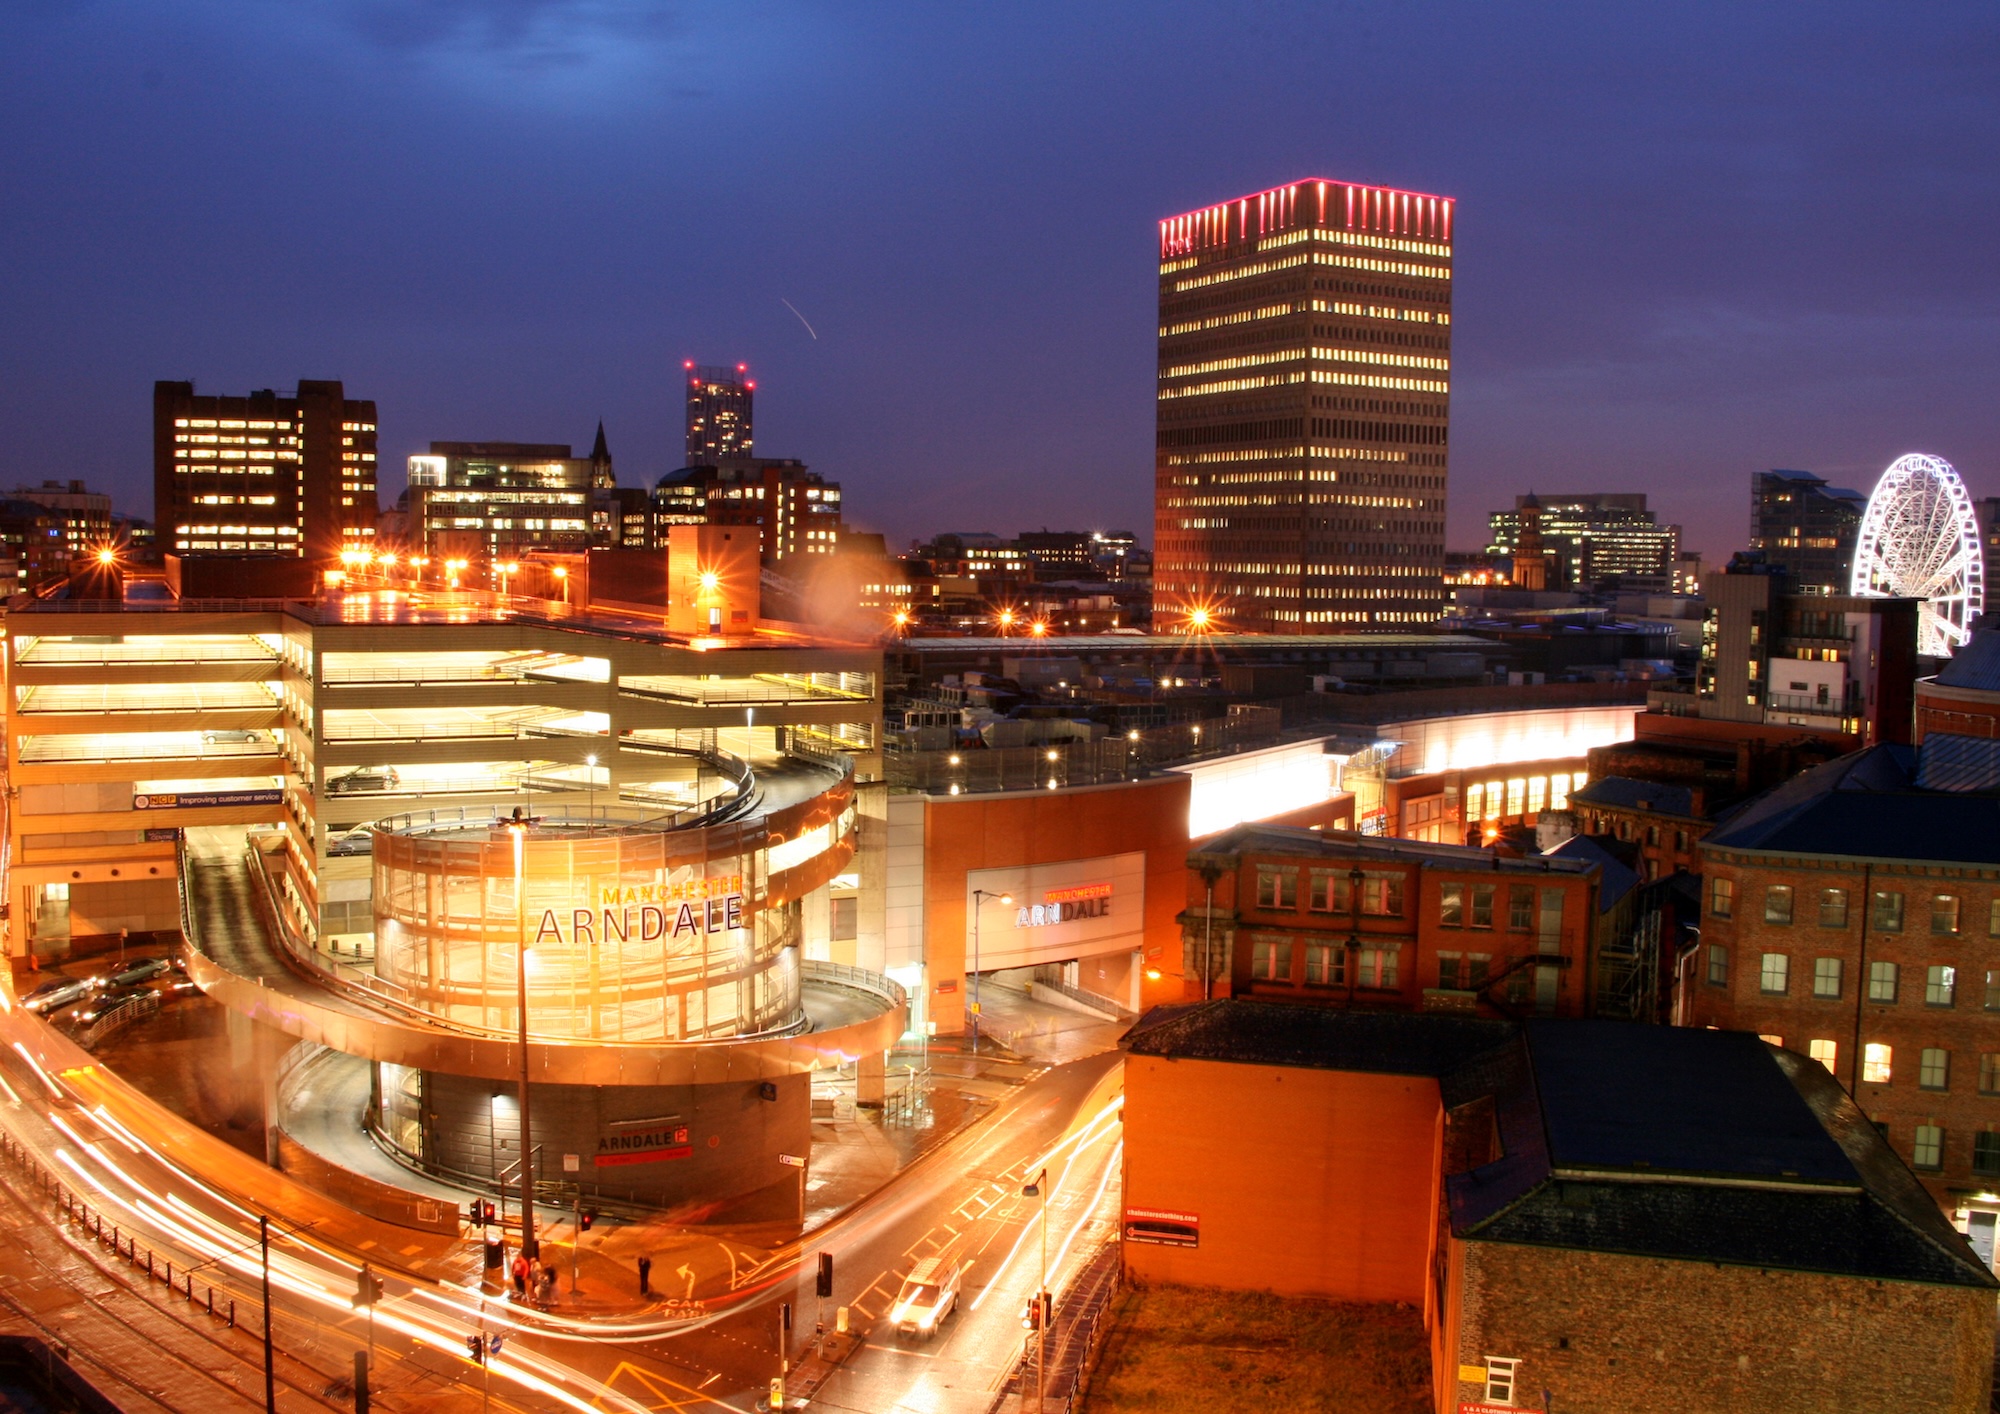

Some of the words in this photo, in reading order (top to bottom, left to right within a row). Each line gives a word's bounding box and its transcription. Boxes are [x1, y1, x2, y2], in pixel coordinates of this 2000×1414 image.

[150, 795, 176, 803] NCP
[180, 796, 217, 804] Improving
[254, 793, 279, 801] service
[602, 876, 740, 904] MANCHESTER
[1045, 885, 1111, 902] MANCHESTER
[535, 895, 741, 944] ARNDALE
[1014, 896, 1110, 928] ARNDALE
[598, 1132, 672, 1151] ARNDALE
[667, 1299, 705, 1309] CAR
